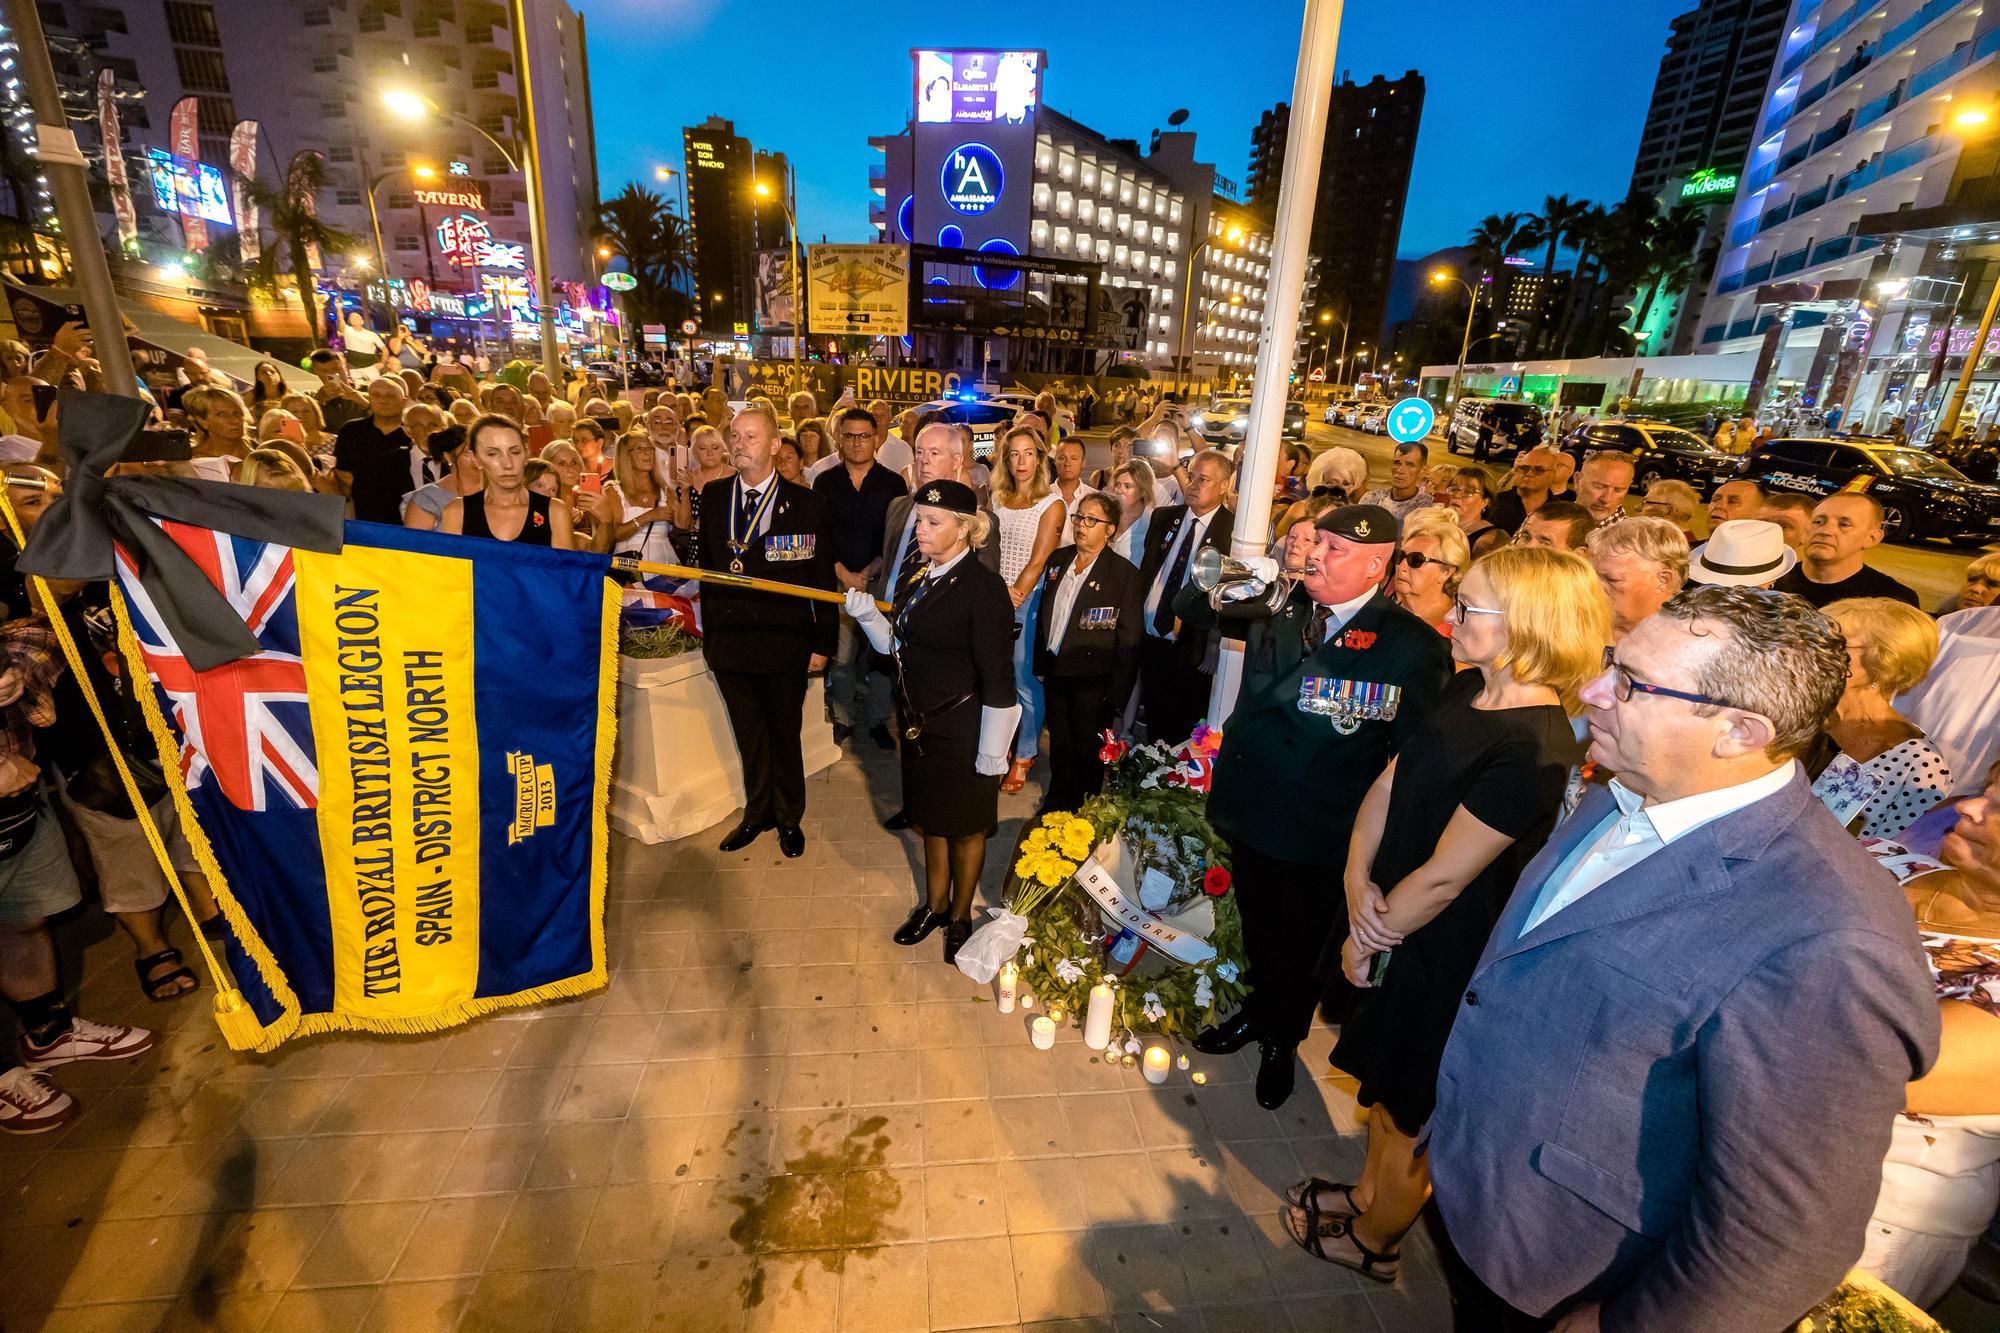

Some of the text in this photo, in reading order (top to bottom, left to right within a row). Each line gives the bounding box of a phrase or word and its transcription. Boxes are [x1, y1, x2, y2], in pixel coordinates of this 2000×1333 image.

[692, 142, 714, 152] HOTEL
[697, 151, 713, 160] DON
[698, 159, 725, 170] PANCHO
[413, 190, 486, 211] TAVERN
[949, 193, 996, 204] AMBASSADOR
[868, 391, 900, 400] MUSIC
[1769, 478, 1829, 496] NACIONAL
[403, 650, 449, 744] NORTH
[334, 583, 402, 1000] THE ROYAL BRITISH LEGION
[518, 757, 534, 835] MAURICE CUP
[540, 780, 553, 813] 2013
[411, 752, 453, 865] DISTRICT
[415, 878, 453, 947] SPAIN
[1089, 874, 1177, 942] BENIDORM
